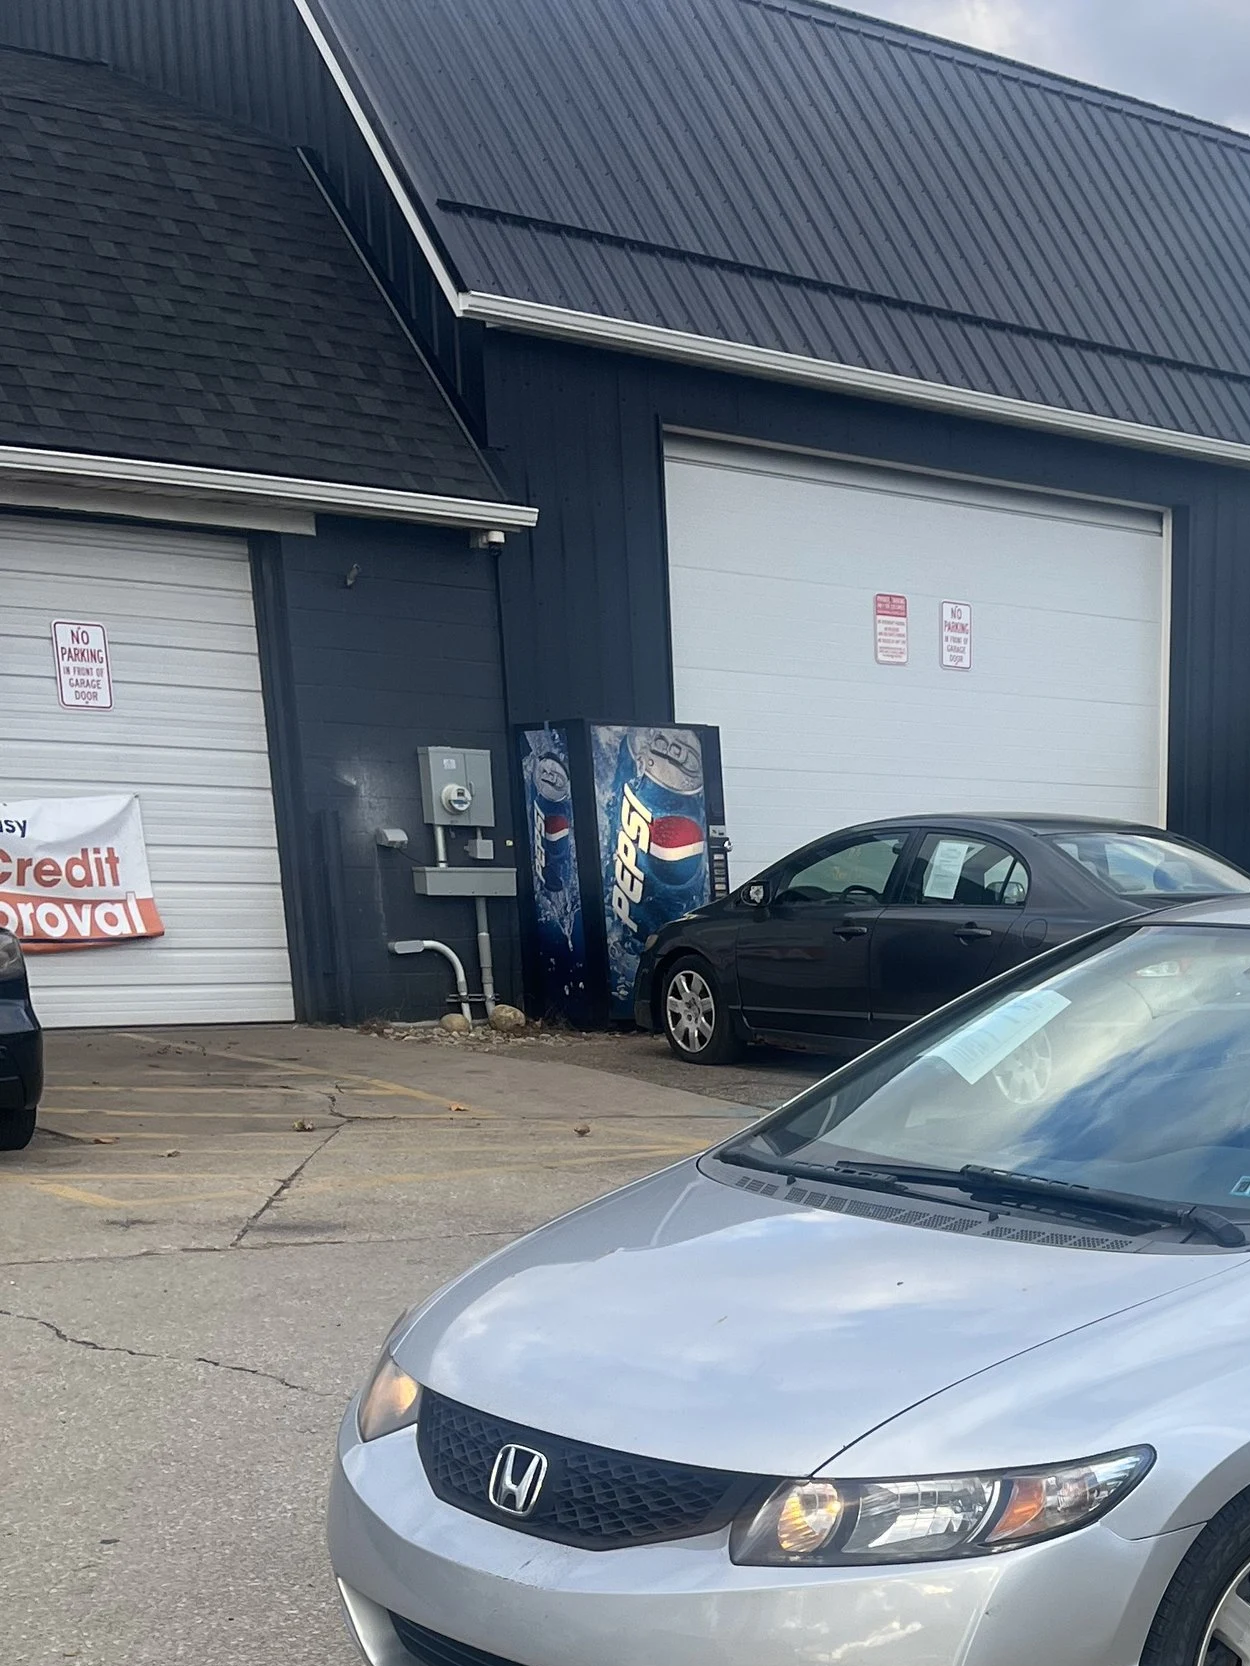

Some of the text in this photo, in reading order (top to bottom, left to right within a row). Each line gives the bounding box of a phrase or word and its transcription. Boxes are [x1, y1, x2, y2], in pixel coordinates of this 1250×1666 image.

[950, 607, 963, 620] NO
[944, 620, 969, 635] PARKING
[71, 629, 90, 645] NO
[61, 647, 104, 664] PARKING
[63, 666, 104, 678] IN FRONT OF
[69, 678, 102, 690] GARAGE
[74, 690, 98, 701] DOOR
[0, 819, 27, 838] sy
[533, 800, 546, 883] PEPSI
[612, 783, 652, 933] PEPSI
